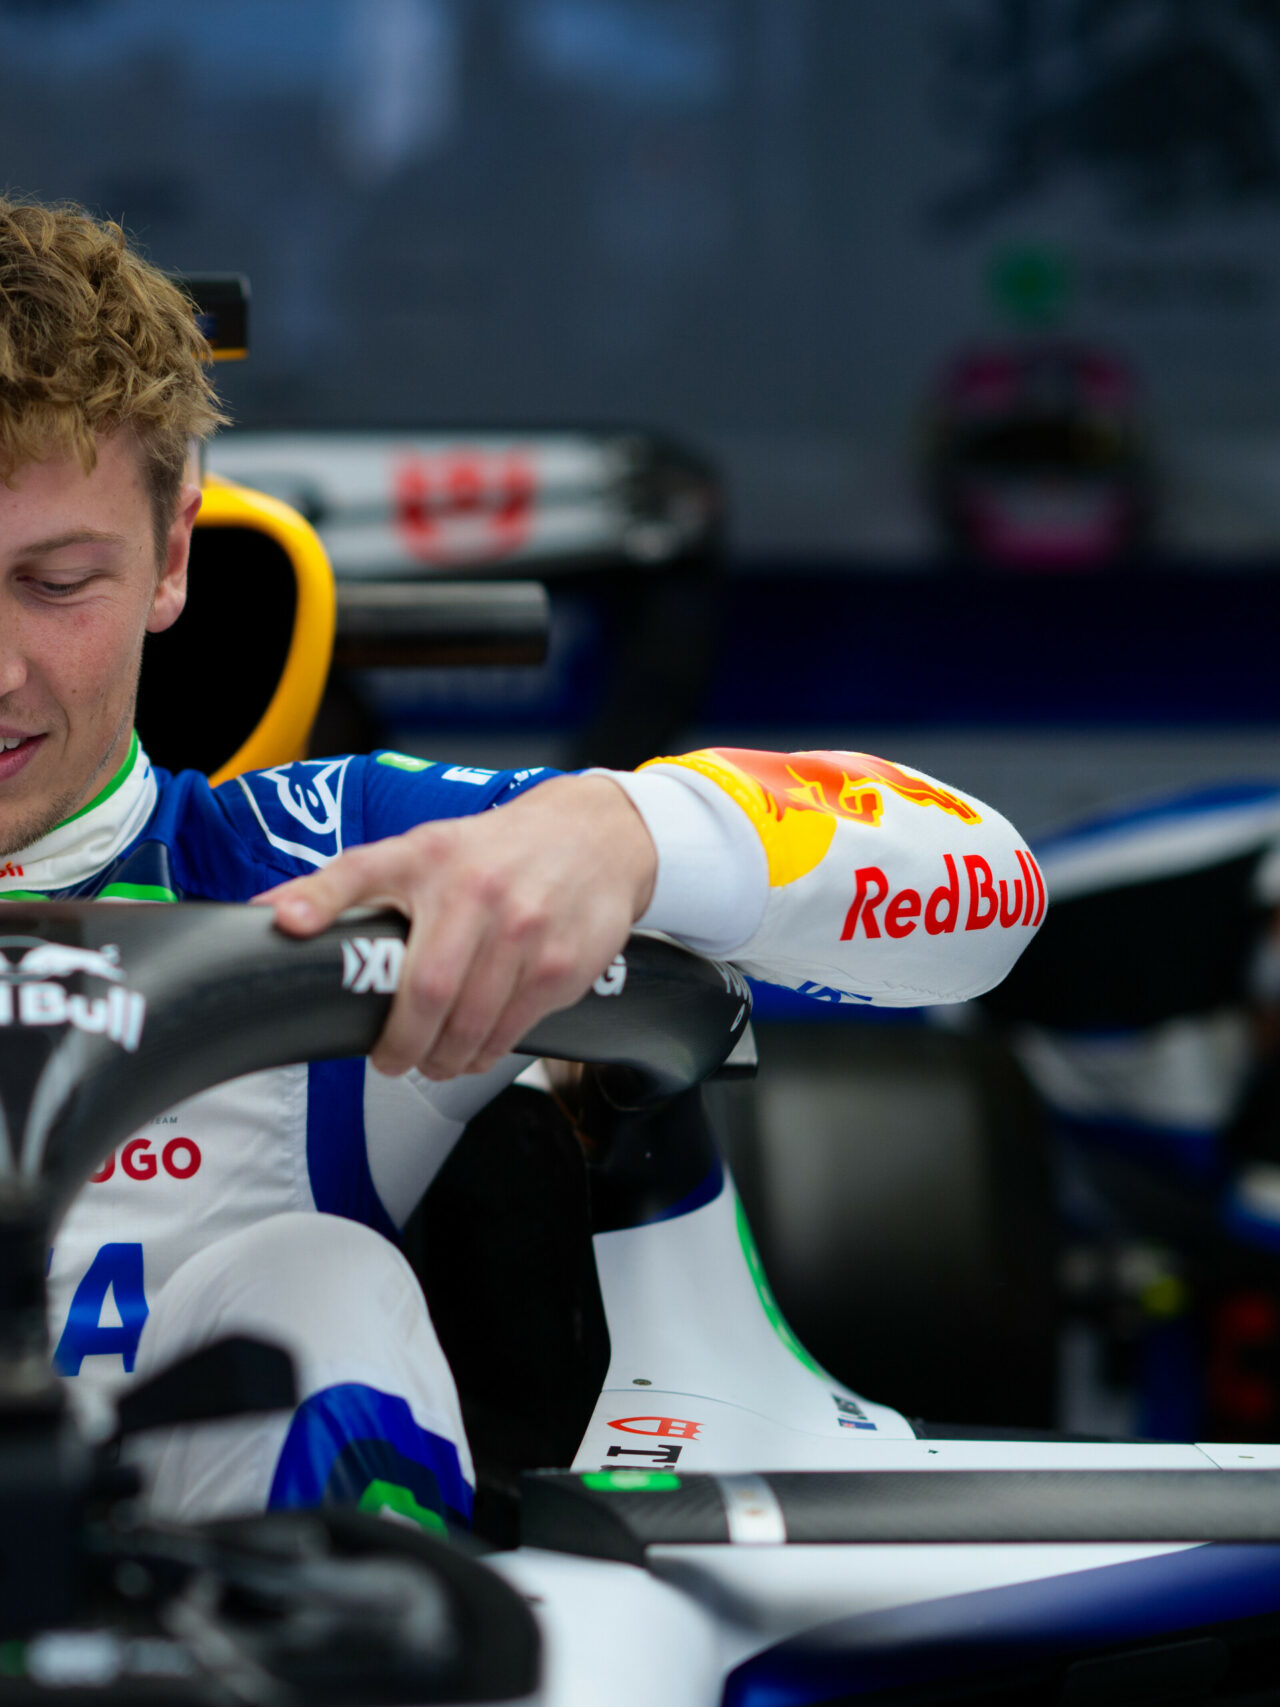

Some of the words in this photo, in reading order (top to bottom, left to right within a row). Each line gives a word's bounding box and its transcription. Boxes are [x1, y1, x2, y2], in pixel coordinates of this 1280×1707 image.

[839, 853, 960, 942] Red
[962, 849, 1046, 931] Bull
[20, 981, 146, 1053] Bull
[87, 1136, 202, 1184] UGO
